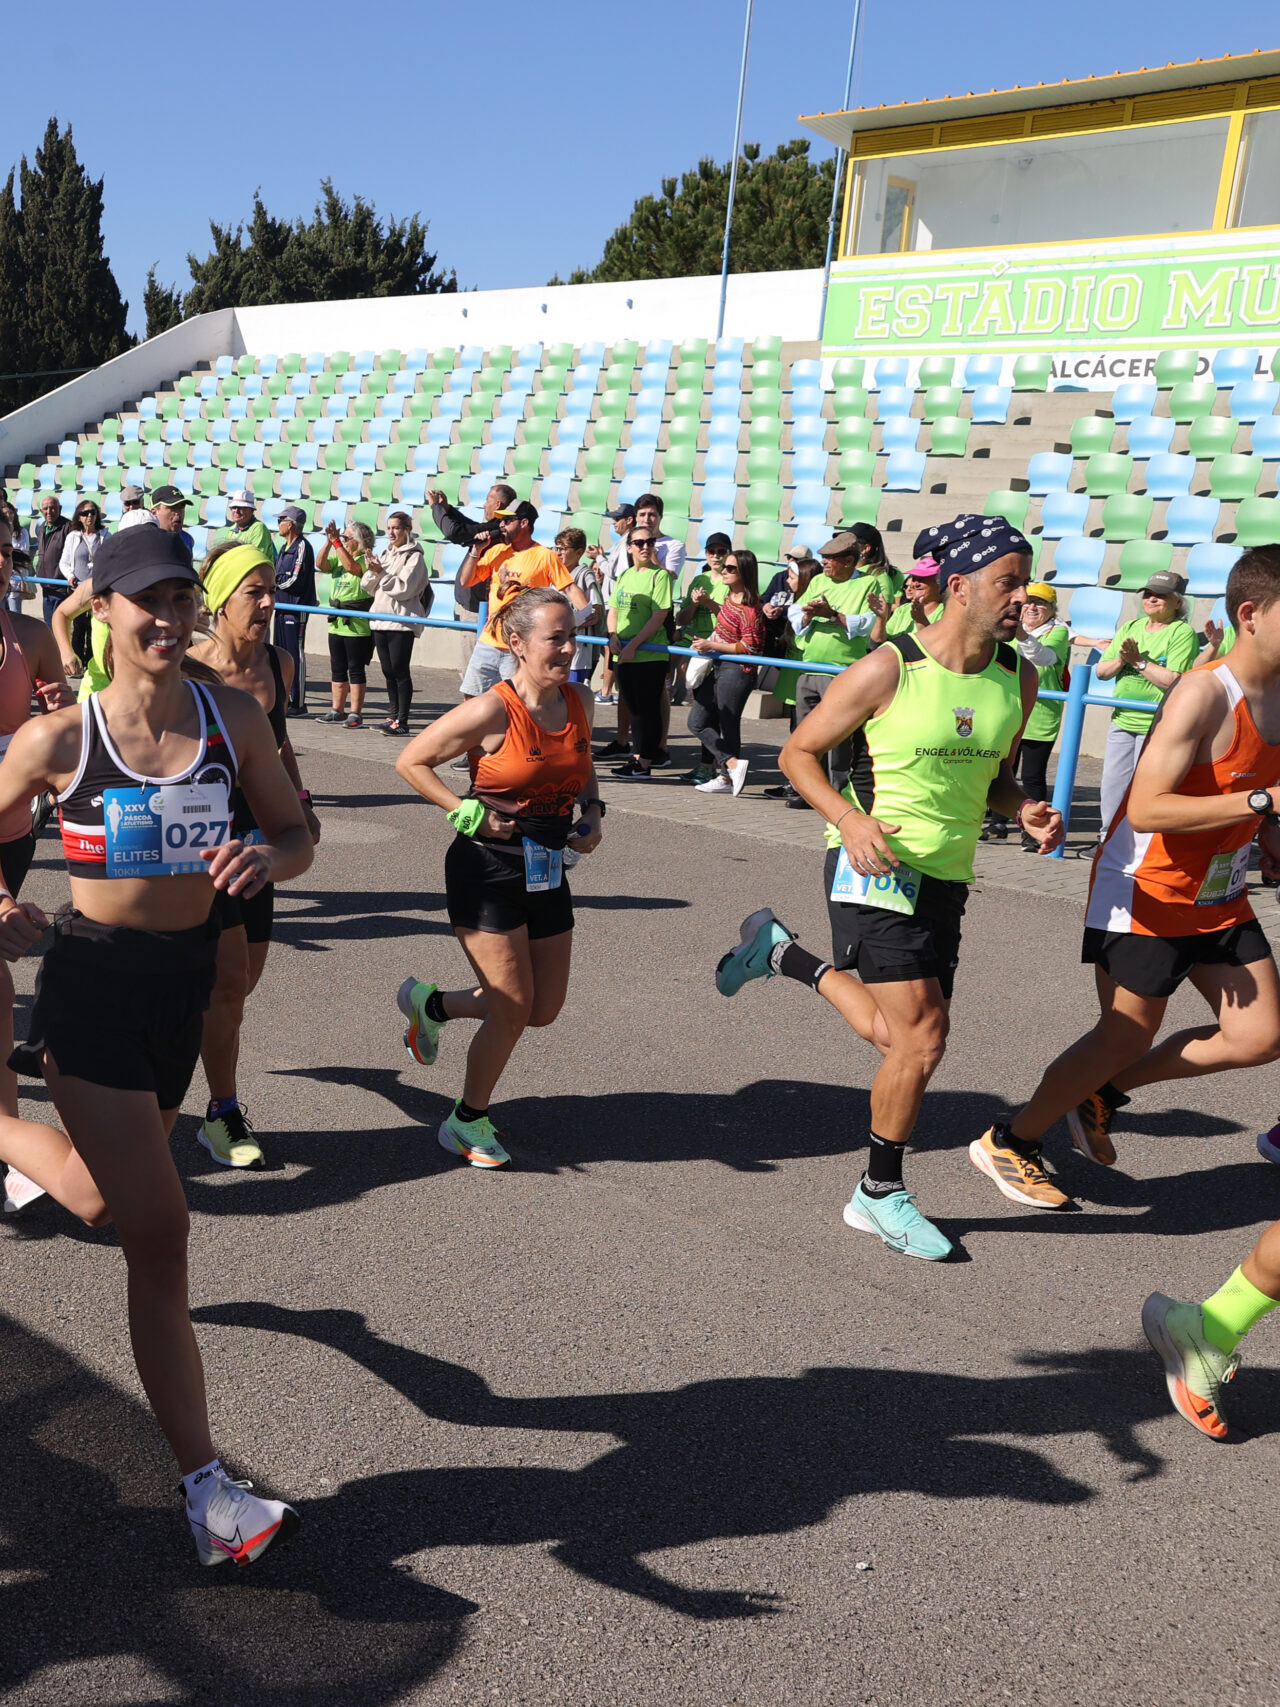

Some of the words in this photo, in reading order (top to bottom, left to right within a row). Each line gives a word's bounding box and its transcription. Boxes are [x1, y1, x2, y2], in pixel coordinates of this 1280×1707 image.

[854, 260, 1144, 340] ESTÁDIO
[981, 545, 997, 556] edp
[124, 803, 146, 813] XXV
[165, 820, 229, 849] 027
[79, 838, 105, 856] The
[113, 850, 160, 863] ELITES
[874, 874, 917, 899] 016
